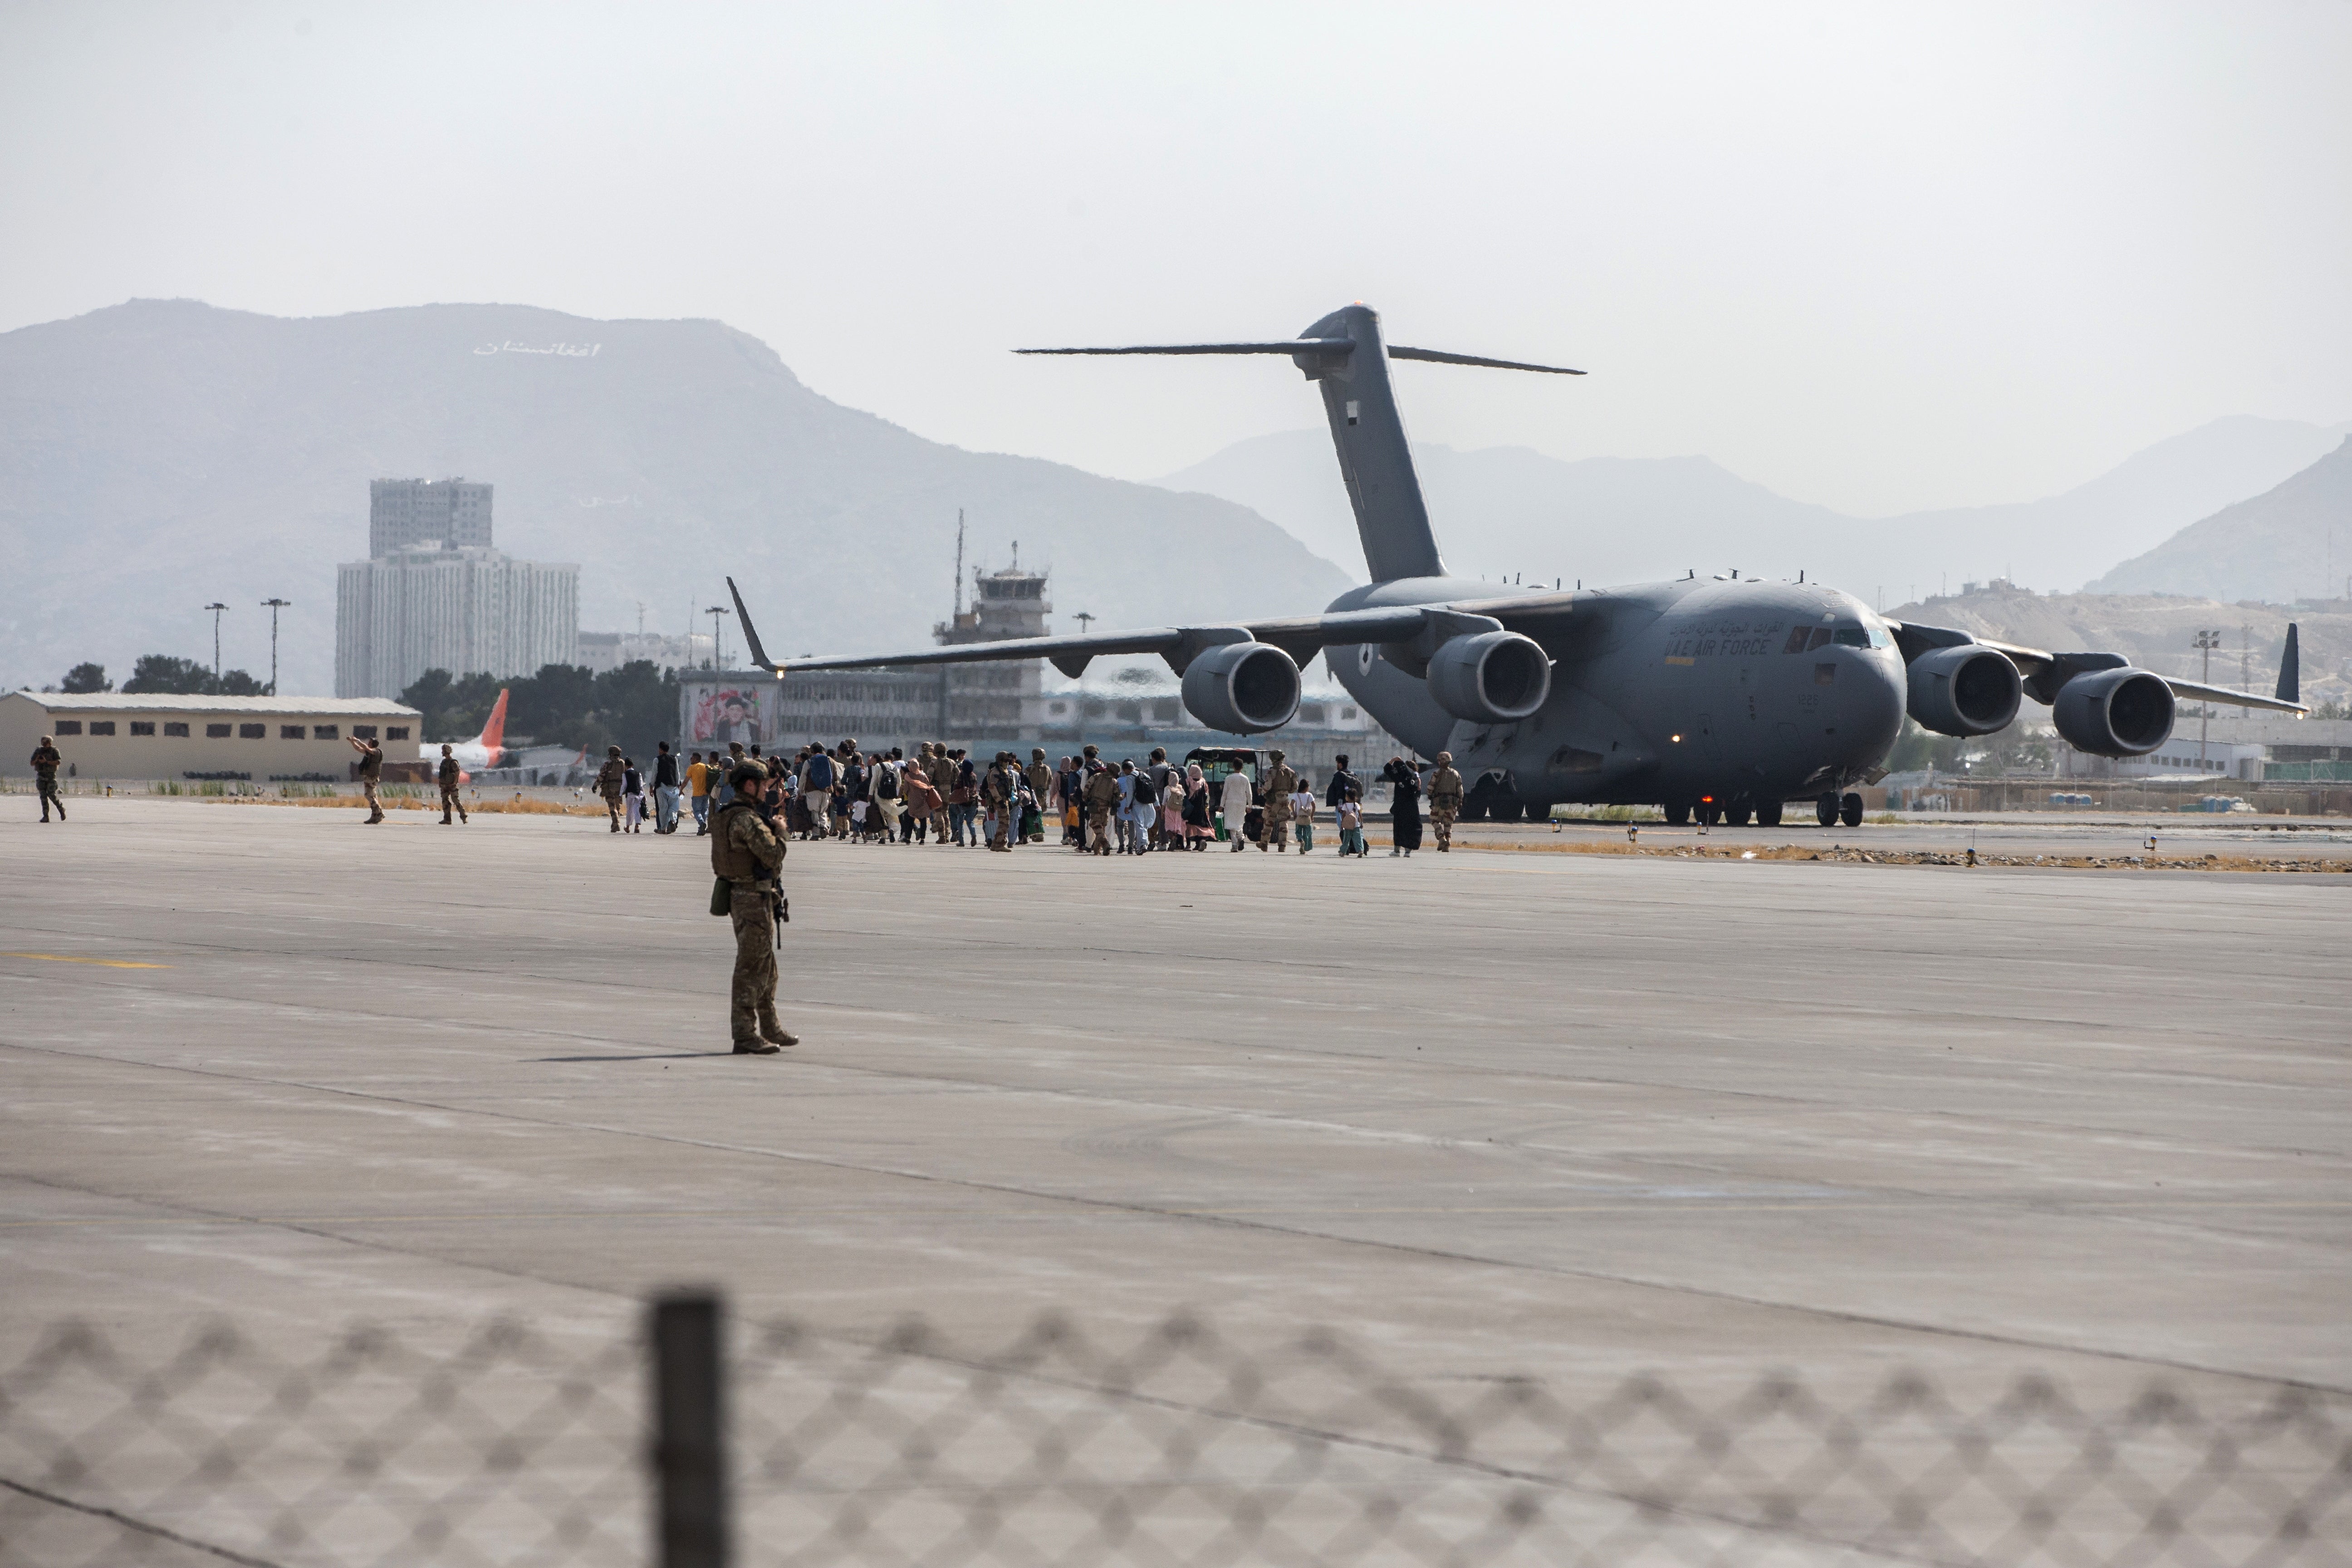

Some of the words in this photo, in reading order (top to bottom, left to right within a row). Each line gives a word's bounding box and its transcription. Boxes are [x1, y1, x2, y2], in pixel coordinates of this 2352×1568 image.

[1692, 639, 1716, 657] AIR
[1719, 638, 1772, 656] FORCE
[1798, 693, 1819, 706] 1226
